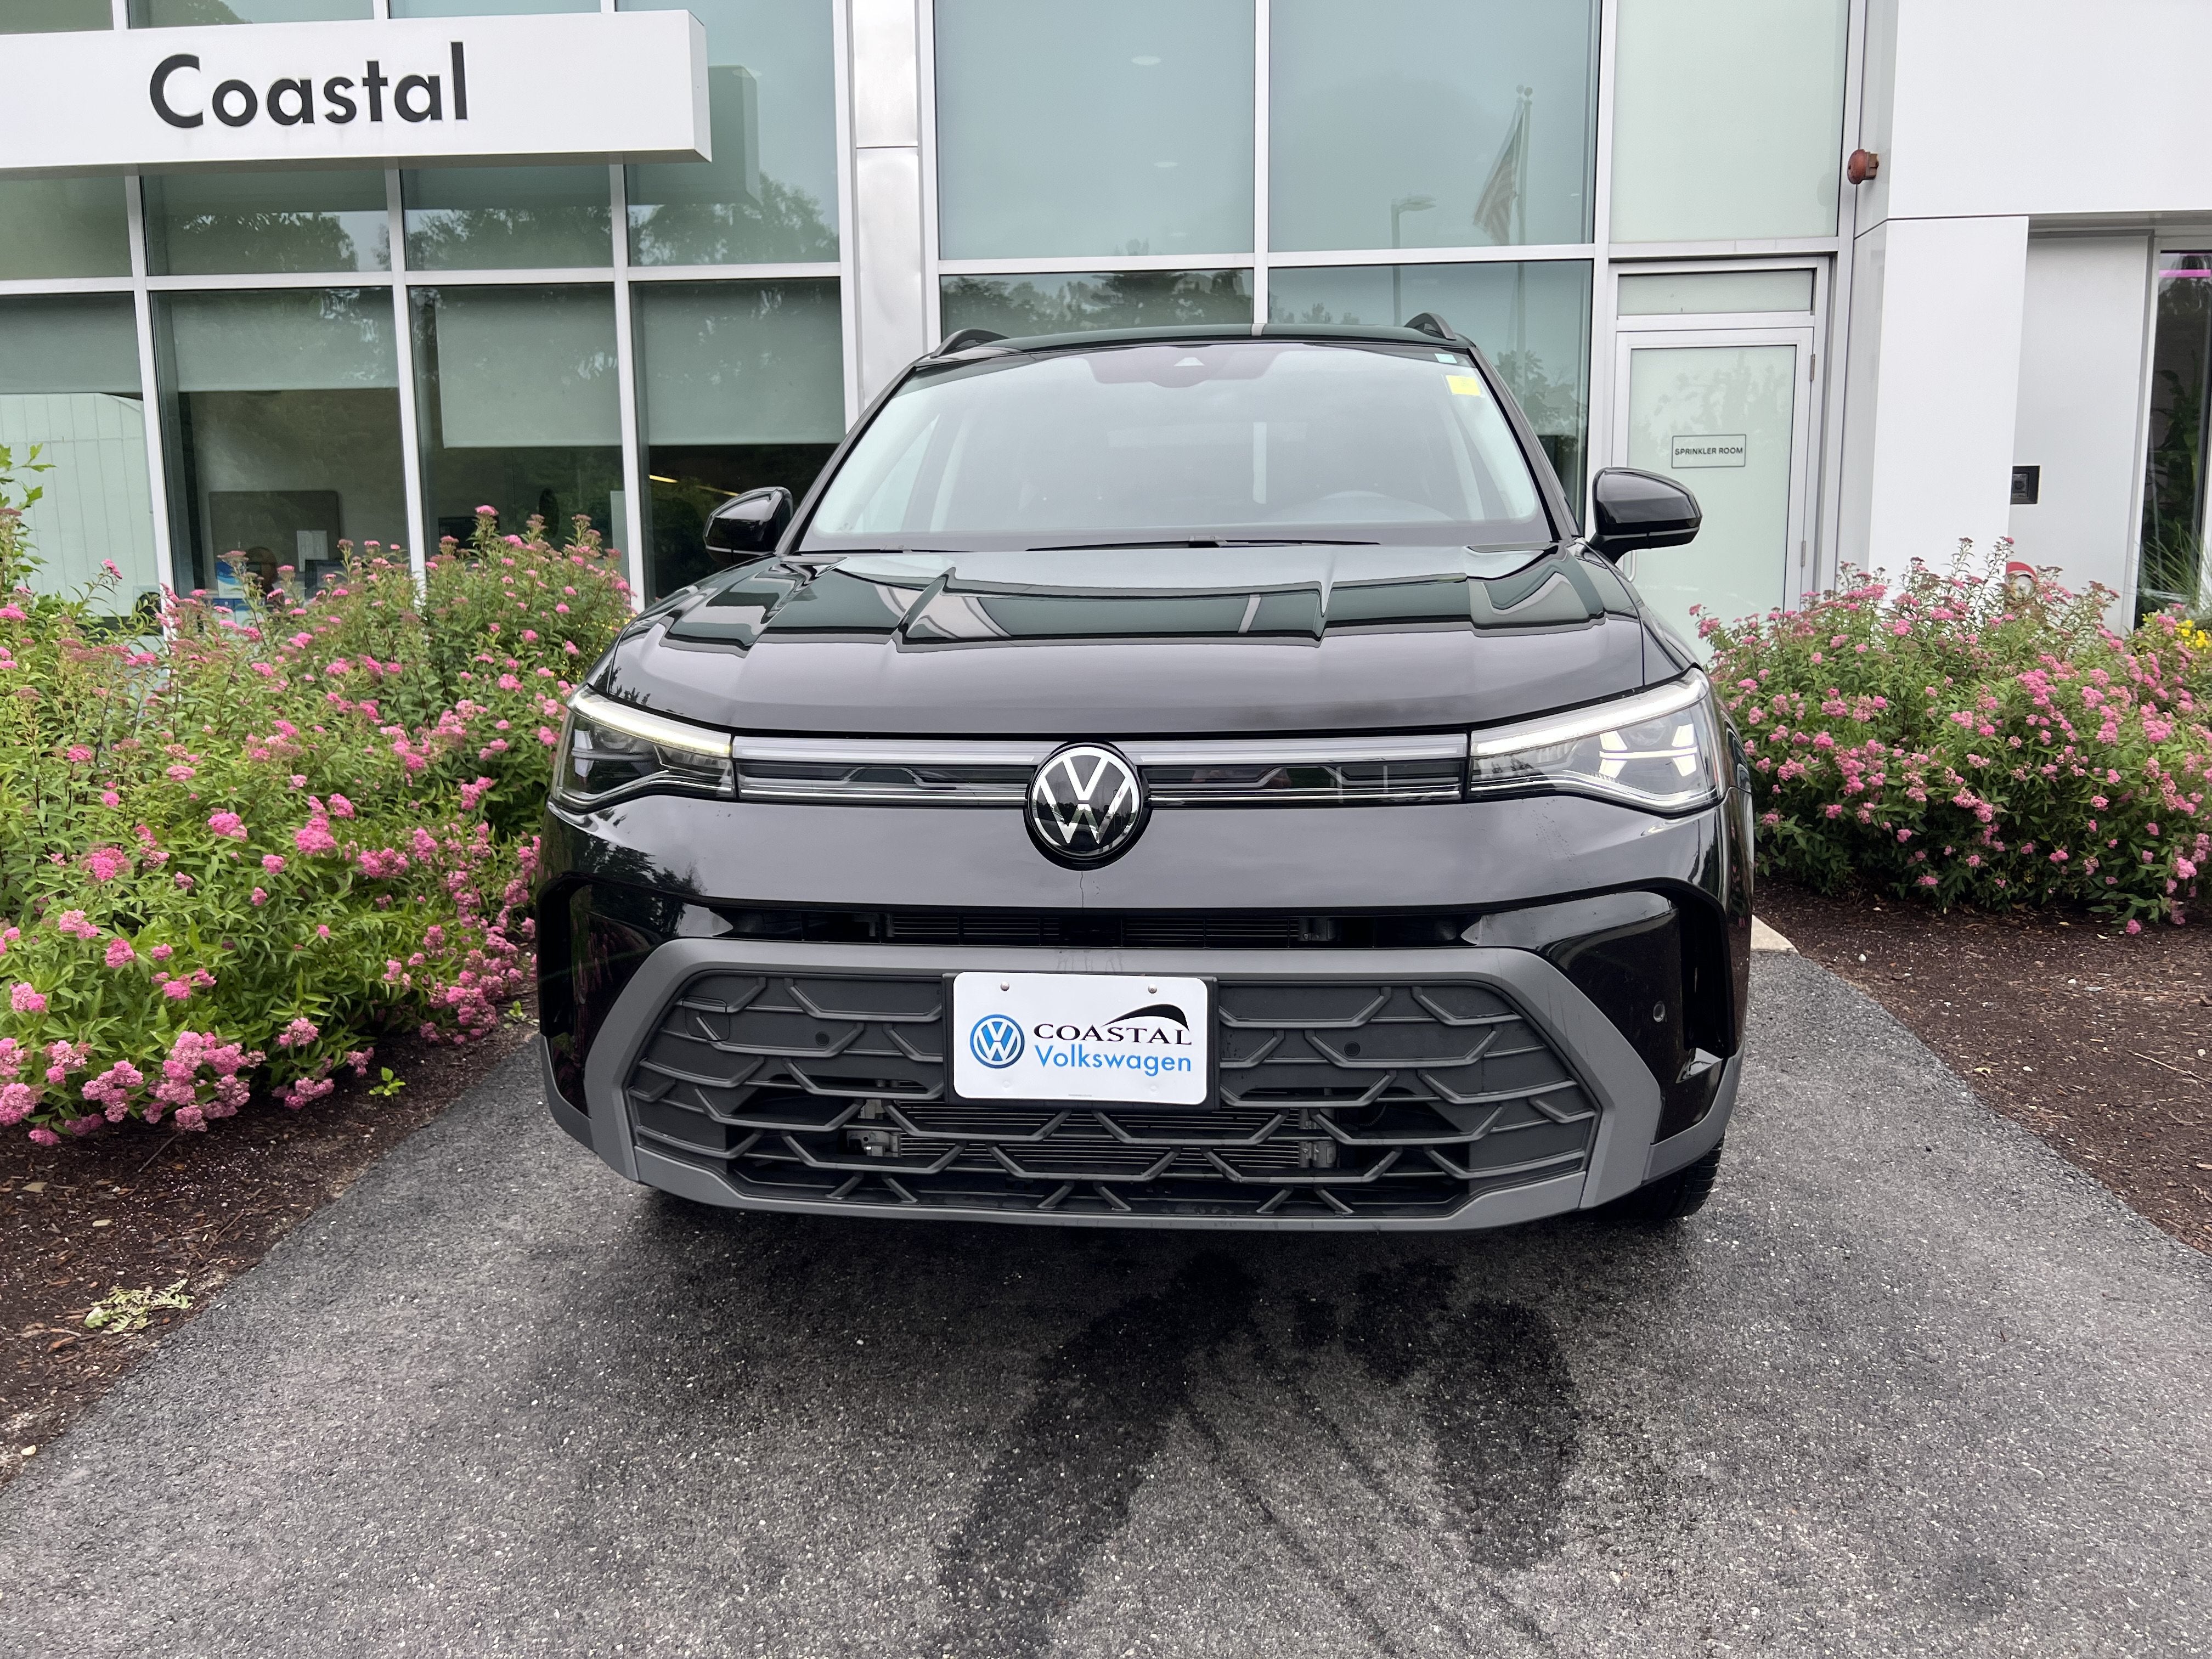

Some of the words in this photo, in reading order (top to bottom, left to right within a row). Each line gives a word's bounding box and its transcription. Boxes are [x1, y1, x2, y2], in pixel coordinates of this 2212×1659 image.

[150, 41, 468, 128] Coastal
[1032, 747, 1139, 856] VW
[970, 1014, 1024, 1068] VW
[1034, 1024, 1192, 1045] COASTAL
[1034, 1044, 1191, 1076] Volkswagen
